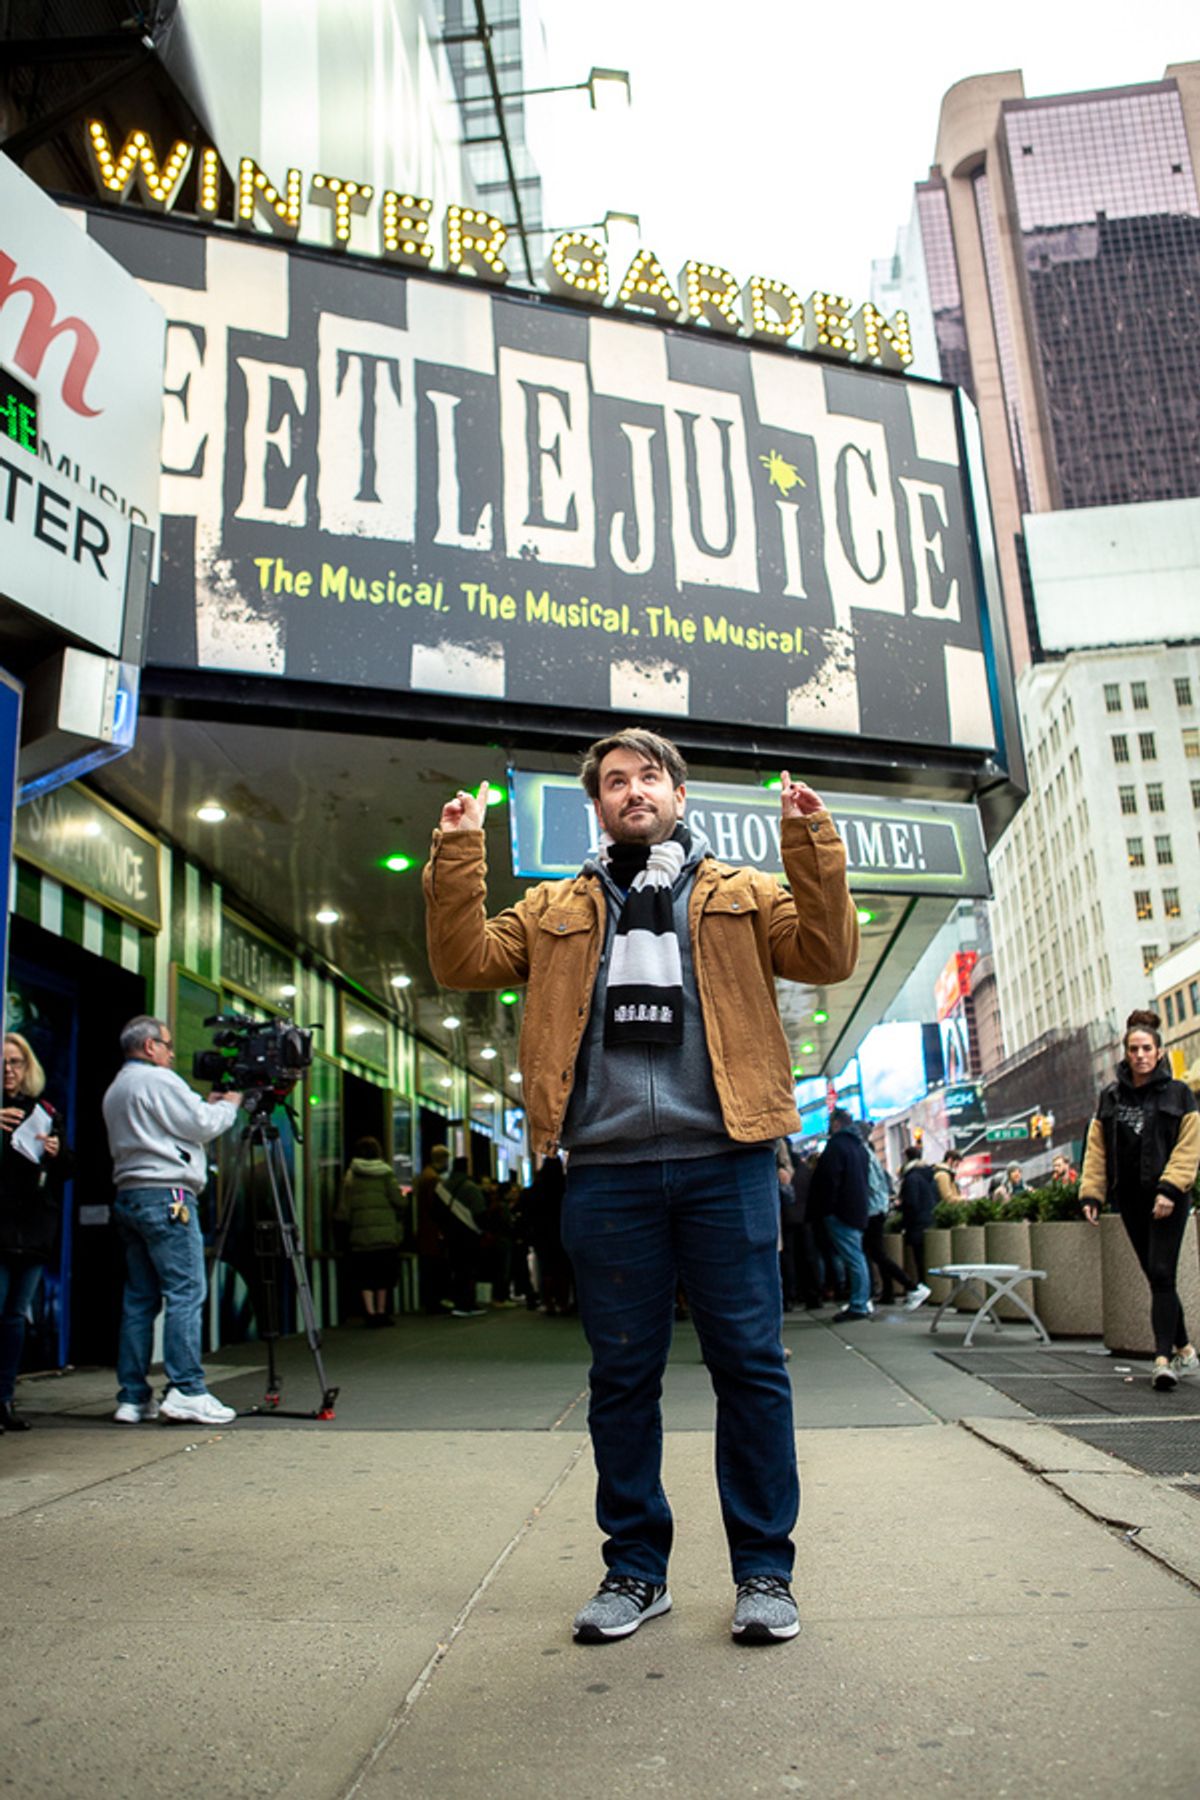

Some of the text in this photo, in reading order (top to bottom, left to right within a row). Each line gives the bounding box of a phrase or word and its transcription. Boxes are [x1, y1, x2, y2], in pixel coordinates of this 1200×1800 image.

[87, 119, 914, 372] WINTER GARDEN
[0, 456, 111, 581] TER
[254, 557, 810, 656] The Musical. The Musical. The Musical.
[689, 810, 926, 870] SHOIME!
